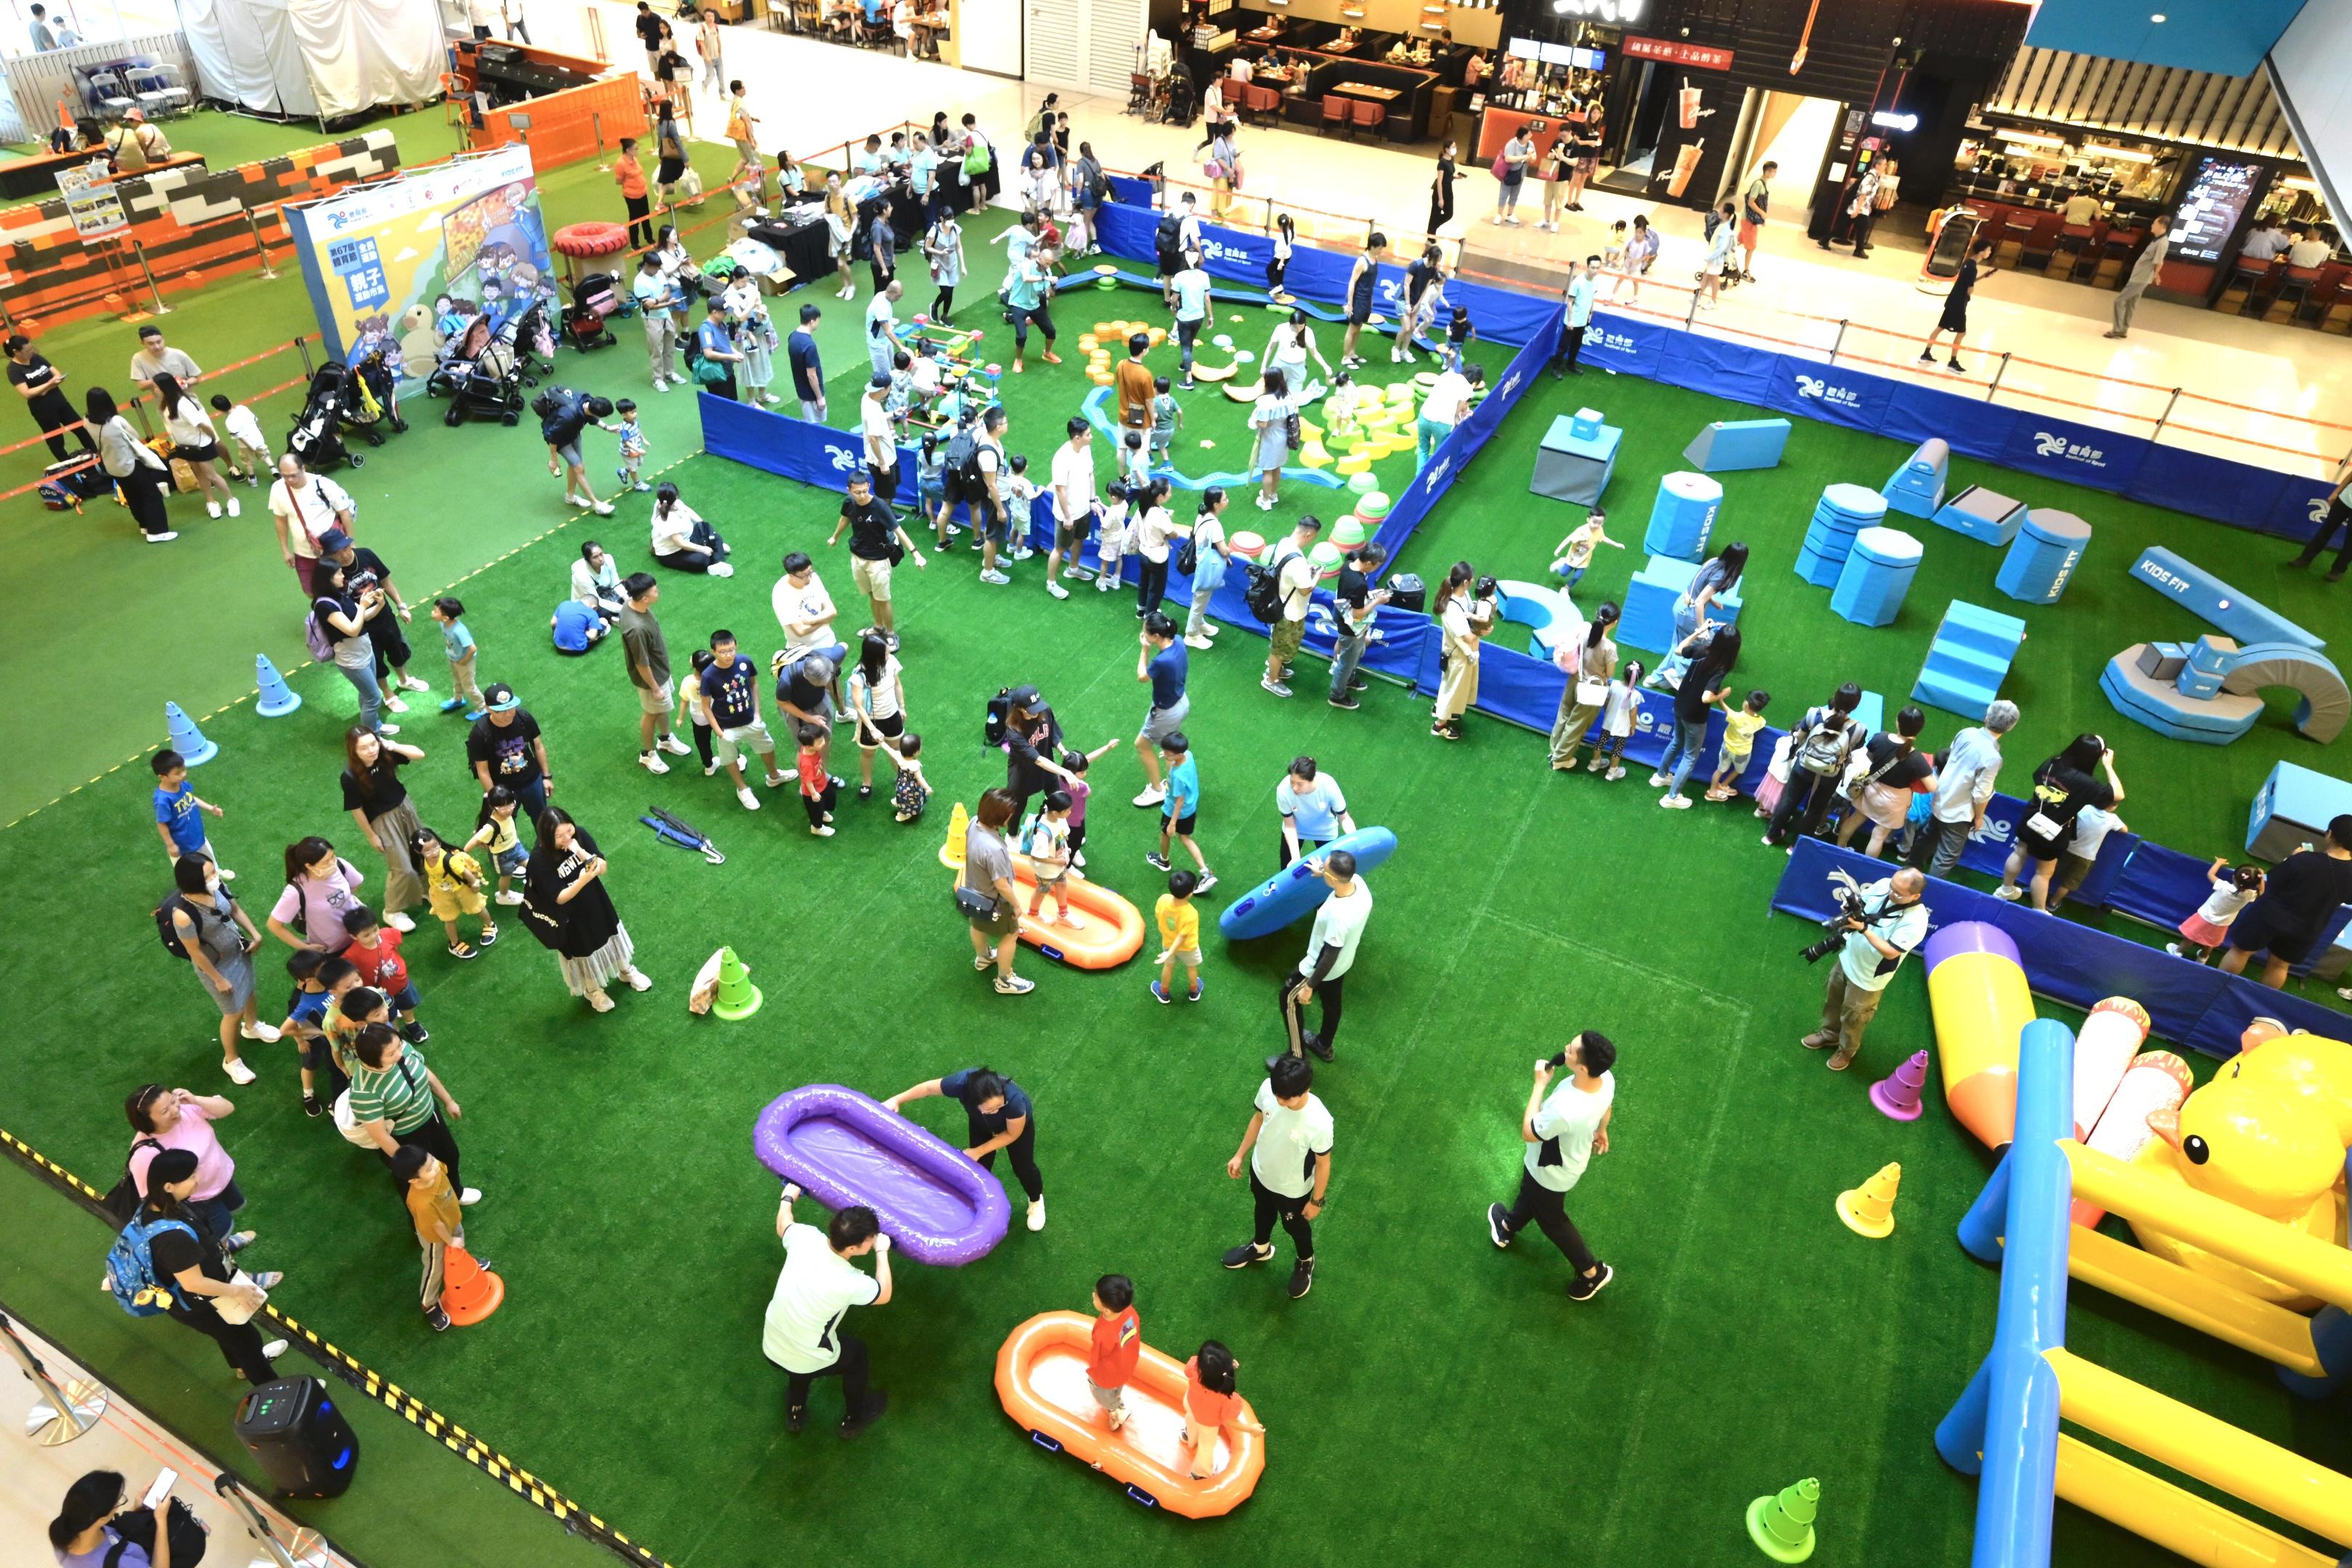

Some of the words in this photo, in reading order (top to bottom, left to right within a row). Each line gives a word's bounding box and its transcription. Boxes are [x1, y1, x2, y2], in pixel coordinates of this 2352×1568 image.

[330, 242, 355, 257] 第67屆
[332, 252, 357, 267] 體育節
[350, 267, 382, 293] 親子
[2065, 453, 2086, 462] Festival
[2091, 459, 2106, 468] Sport
[2067, 444, 2103, 460] 體育節
[1701, 505, 1717, 535] KIDS
[1695, 536, 1707, 553] FIT
[2048, 569, 2070, 597] KIDS
[2062, 550, 2078, 568] FIT
[2140, 559, 2173, 583] KIDS
[2168, 576, 2190, 593] FIT
